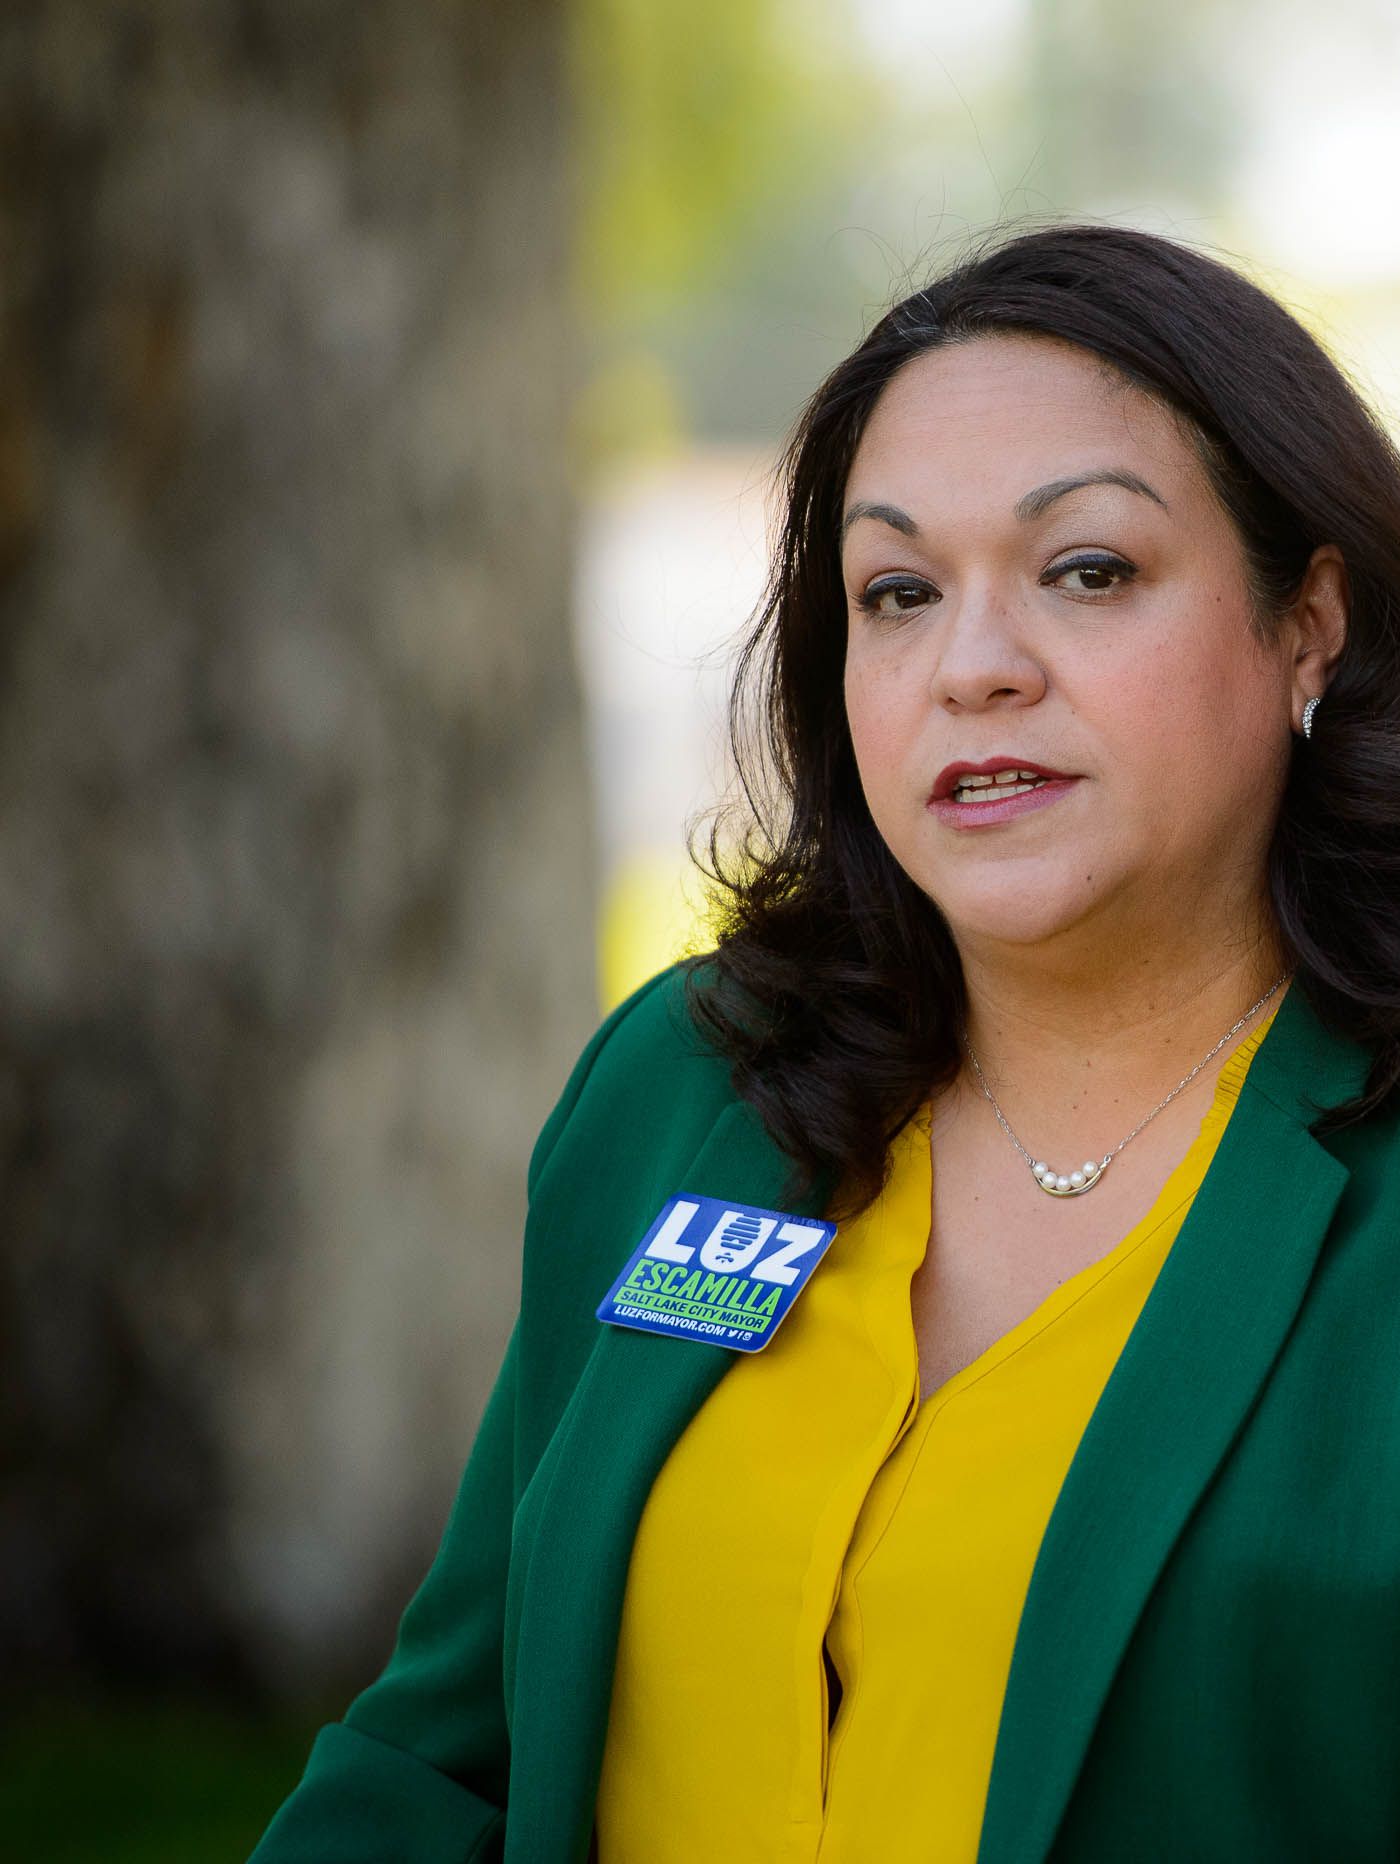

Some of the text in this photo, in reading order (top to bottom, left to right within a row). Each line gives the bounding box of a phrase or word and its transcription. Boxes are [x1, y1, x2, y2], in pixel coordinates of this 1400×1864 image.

[645, 1200, 826, 1286] LUZ
[620, 1290, 764, 1329] SALT LAKE CITY MAYOR
[625, 1258, 784, 1316] ESCAMILLA
[614, 1304, 726, 1337] LUZFORMAYOR.COM
